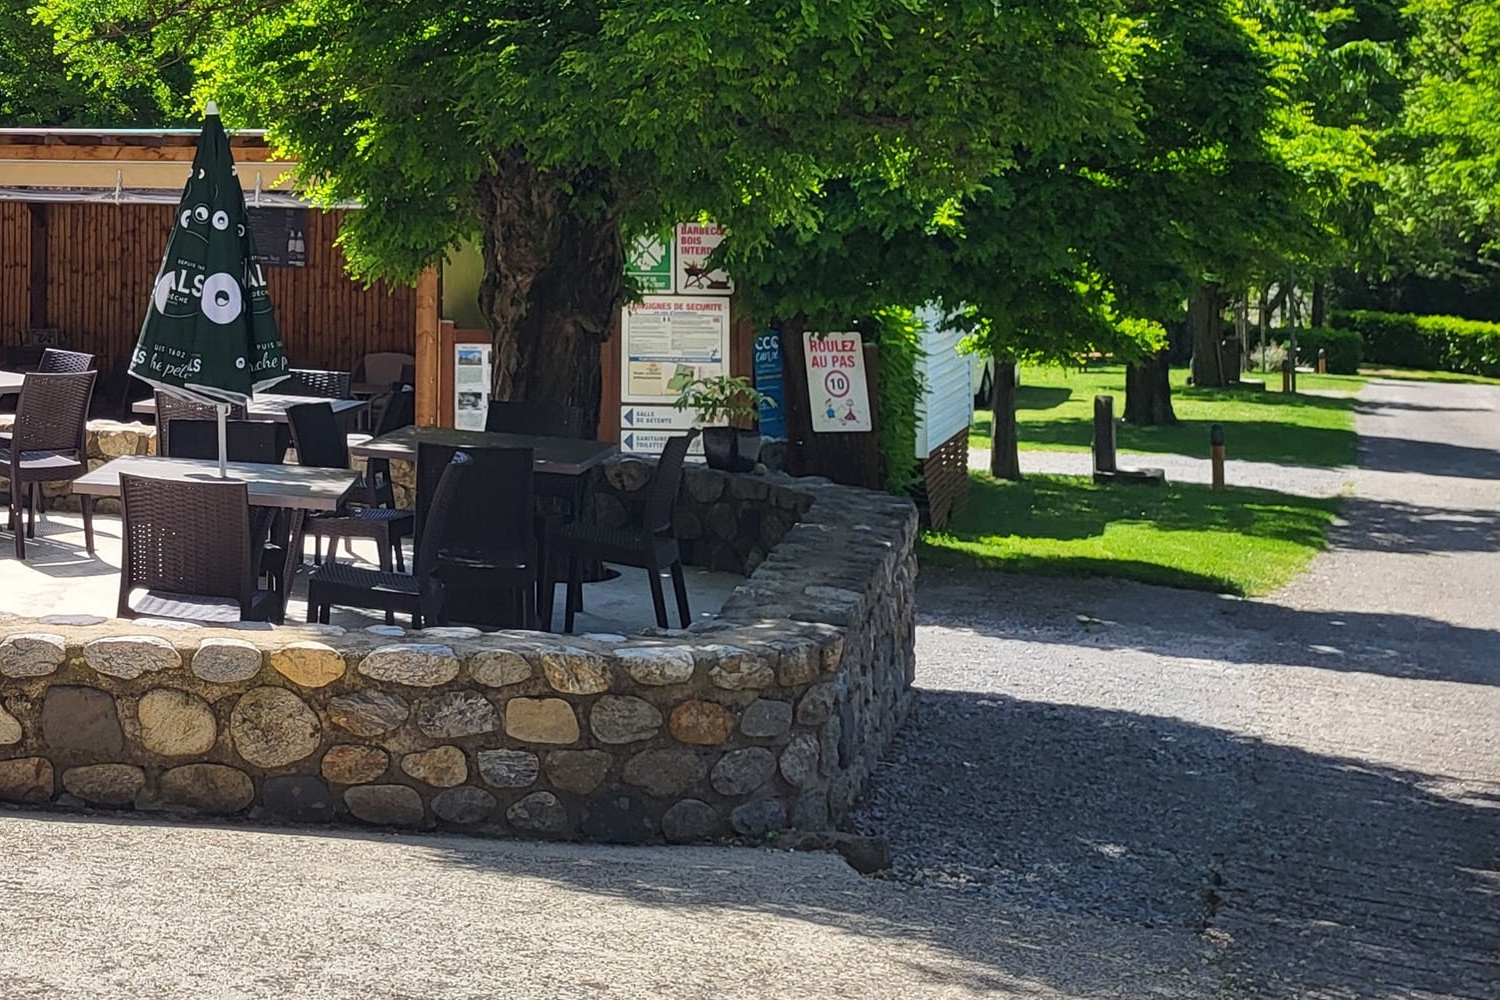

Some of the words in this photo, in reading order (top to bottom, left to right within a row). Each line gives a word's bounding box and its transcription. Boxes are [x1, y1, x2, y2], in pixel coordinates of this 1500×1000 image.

[681, 236, 701, 245] BOIS
[674, 302, 683, 310] DE
[809, 339, 856, 353] ROULEZ
[811, 355, 827, 368] AU
[831, 355, 855, 368] PAS
[830, 378, 845, 390] 10
